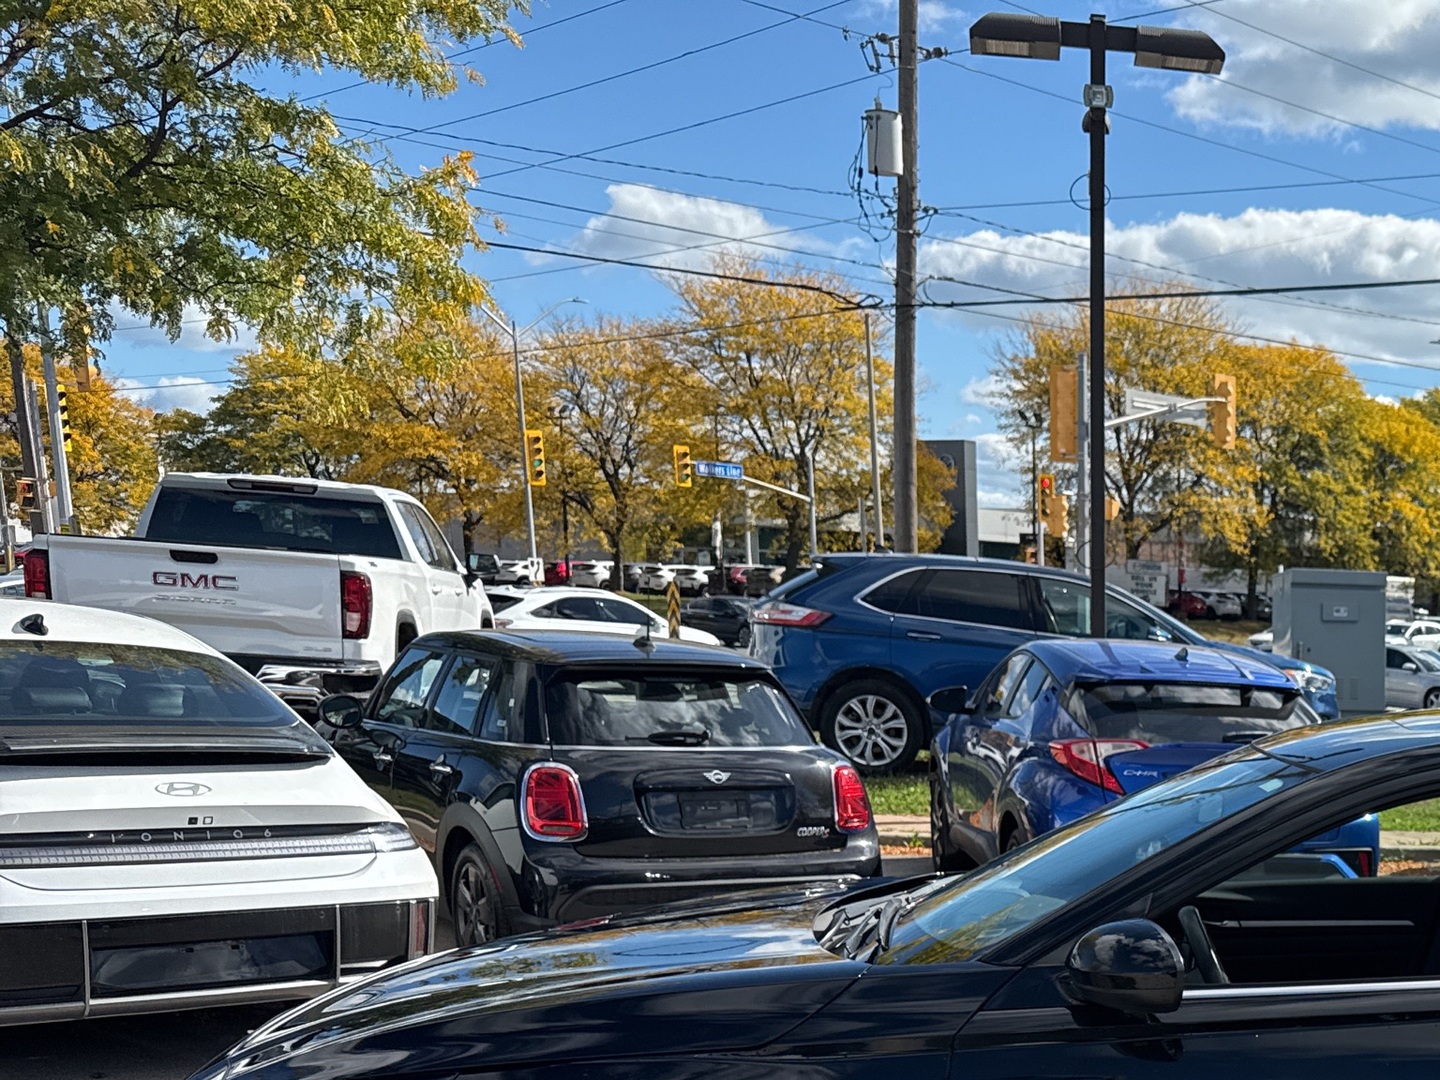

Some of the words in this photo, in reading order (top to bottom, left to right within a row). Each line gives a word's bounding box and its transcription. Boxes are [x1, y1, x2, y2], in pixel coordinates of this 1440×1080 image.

[699, 463, 725, 476] Walkers
[726, 466, 741, 478] Line
[152, 571, 239, 591] GMC
[797, 826, 825, 837] COOPER
